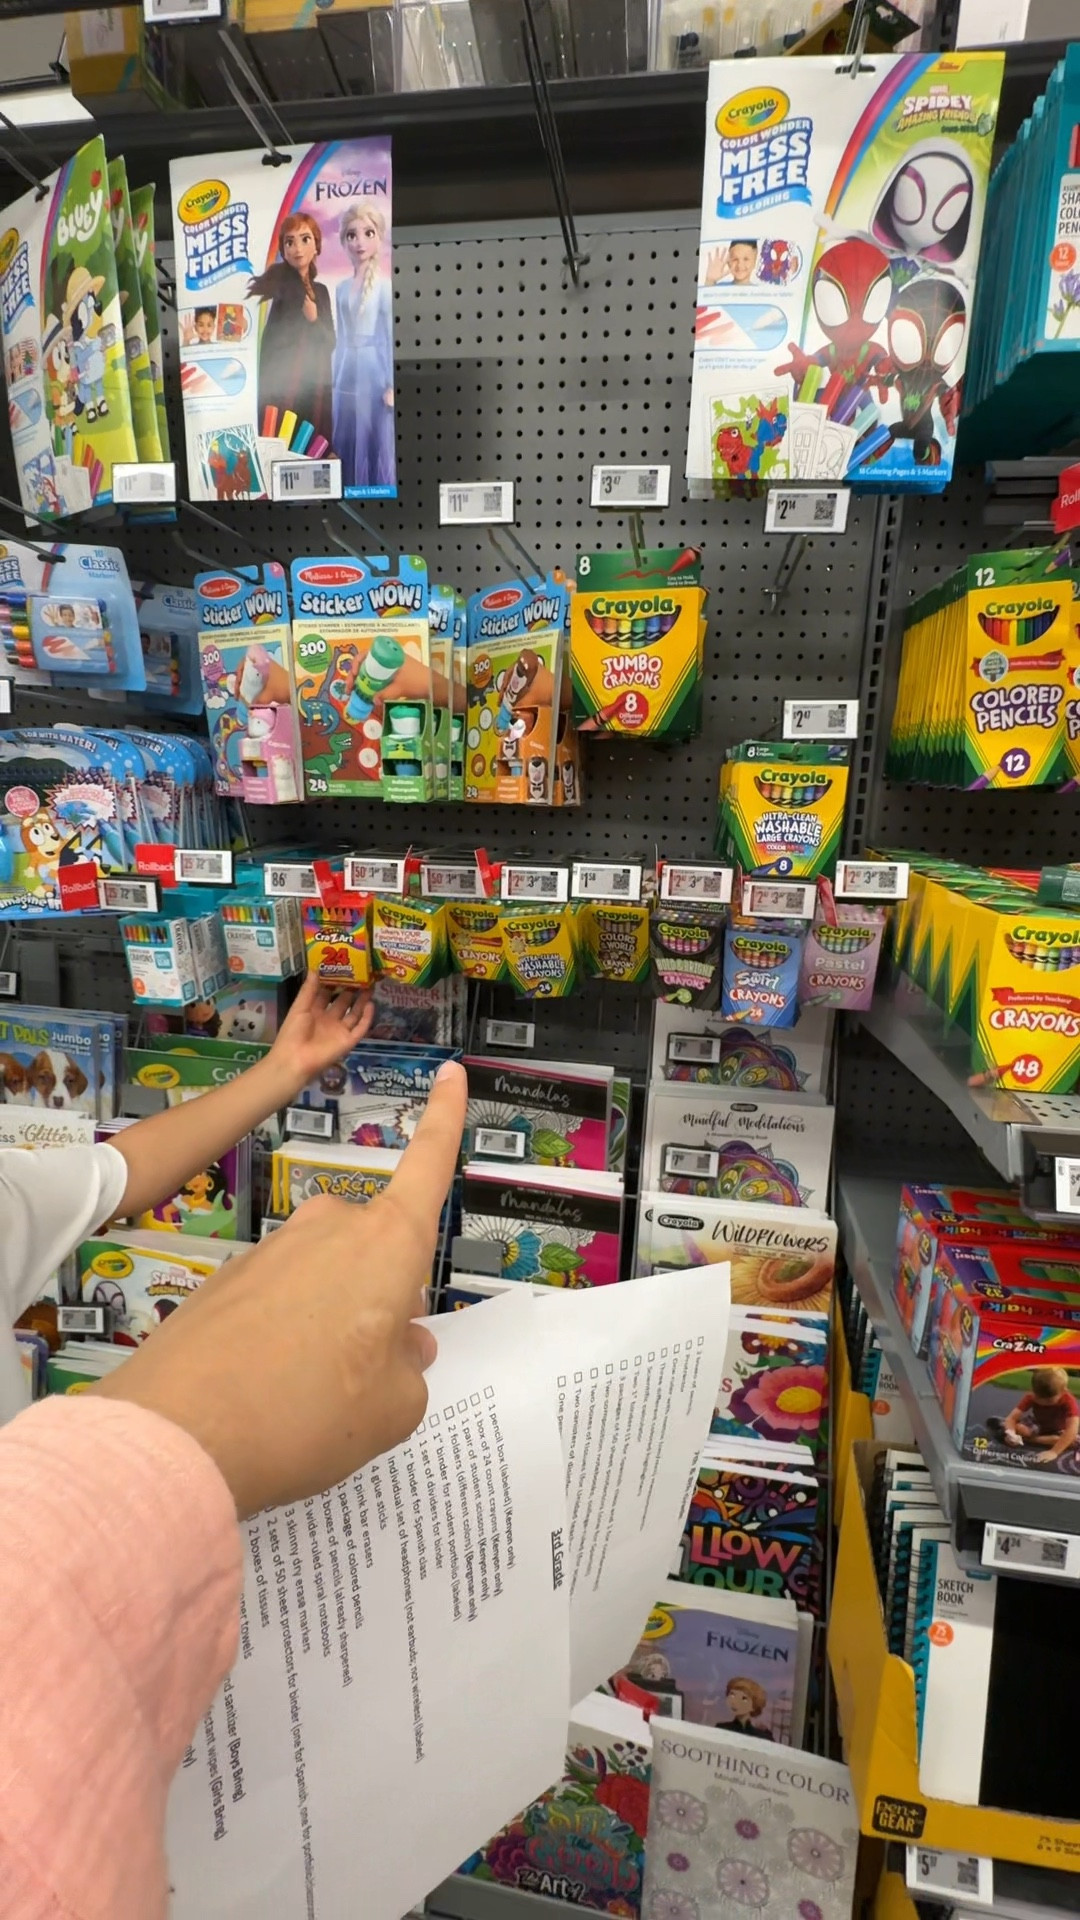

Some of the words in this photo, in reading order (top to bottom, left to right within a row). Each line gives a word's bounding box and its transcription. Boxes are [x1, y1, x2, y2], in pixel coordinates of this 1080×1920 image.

[728, 97, 775, 119] Crayola
[903, 95, 972, 116] SPIDEY
[722, 134, 757, 150] COLOR
[760, 119, 810, 139] WONDER
[722, 132, 809, 177] MESS
[315, 178, 387, 201] FROZEN
[722, 159, 806, 204] FREE
[185, 188, 222, 208] Crayola
[735, 191, 790, 217] COLORING
[184, 218, 211, 234] COLOR
[212, 204, 248, 225] WONDER
[186, 215, 247, 256] MESS
[189, 236, 247, 278] FREE
[79, 556, 120, 572] Classic
[579, 556, 591, 575] 8
[975, 568, 996, 586] 12
[202, 604, 243, 626] Sticker
[244, 590, 283, 618] WOW!
[300, 591, 364, 616] Sticker
[369, 584, 423, 610] WOW!
[592, 595, 674, 618] Crayola
[986, 598, 1053, 616] Crayola
[481, 613, 519, 636] Sticker
[523, 596, 560, 622] WOW!
[299, 640, 327, 657] 300
[203, 653, 220, 665] 300
[473, 659, 490, 675] 300
[602, 654, 662, 673] JUMBO
[603, 671, 660, 689] CRAYONS
[625, 693, 638, 712] 8
[972, 686, 1063, 712] COLORED
[977, 705, 1057, 733] PENCILS
[59, 734, 97, 752] WATER!
[747, 747, 755, 757] 8
[1006, 754, 1025, 771] 12
[216, 780, 230, 792] 24
[308, 778, 327, 792] 24
[761, 769, 827, 785] Crayola
[466, 785, 478, 797] 24
[763, 812, 818, 822] ULTRA-CLEAN
[755, 820, 823, 838] WASHABLE
[756, 833, 781, 843] LARGE
[784, 834, 820, 847] CRAYONS
[138, 862, 174, 873] Rollback
[779, 859, 787, 871] 8
[62, 880, 96, 894] Rollback
[381, 906, 423, 925] Crayola
[453, 907, 496, 919] Crayola
[597, 910, 640, 921] Crayola
[508, 918, 556, 931] Crayola
[658, 924, 709, 940] Crayola
[819, 925, 871, 938] Crayola
[600, 933, 636, 943] COLORS
[607, 942, 635, 952] WORLD
[736, 937, 787, 953] Crayola
[321, 947, 349, 965] 24
[458, 950, 501, 964] CRAYONS
[815, 958, 865, 971] Pastel
[319, 963, 352, 972] Crayons
[396, 967, 405, 975] 24
[476, 965, 485, 974] 24
[517, 959, 566, 973] WASHABLE
[524, 969, 563, 979] CRAYONS
[539, 983, 551, 992] 24
[664, 975, 705, 990] CRAYONS
[809, 974, 865, 991] CRAYONS
[730, 989, 786, 1008] CRAYONS
[750, 1008, 762, 1018] 24
[991, 1008, 1080, 1037] CRAYONS
[12, 1024, 49, 1046] PALS
[52, 1032, 91, 1045] Jumbo
[1013, 1058, 1039, 1077] 48
[494, 1075, 571, 1109] Mandalas
[682, 1110, 730, 1131] Mindful
[738, 1113, 805, 1133] Meditations
[24, 1124, 74, 1143] Glitter
[500, 1190, 583, 1222] Mandalas
[659, 1215, 700, 1228] Crayola
[460, 1427, 473, 1447] pair
[476, 1420, 486, 1439] box
[489, 1414, 503, 1443] pencil
[450, 1434, 464, 1470] folders
[481, 1443, 490, 1453] of
[974, 1436, 988, 1449] 12
[467, 1450, 477, 1459] of
[482, 1455, 492, 1466] 24
[497, 1446, 506, 1463] box
[370, 1475, 383, 1499] glue
[406, 1463, 419, 1497] binder
[470, 1462, 482, 1500] student
[485, 1468, 495, 1496] count
[498, 1464, 512, 1507] (labeled)
[352, 1484, 368, 1508] pink
[455, 1472, 470, 1517] (different
[376, 1501, 388, 1530] sticks
[412, 1500, 423, 1515] for
[489, 1498, 499, 1533] crayons
[358, 1511, 370, 1528] bar
[476, 1502, 486, 1537] scissors
[503, 1507, 514, 1545] (Kenyon
[285, 1520, 301, 1557] skinny
[413, 1516, 427, 1555] Spanish
[462, 1519, 472, 1551] colors)
[553, 1528, 563, 1549] 3rd
[362, 1531, 375, 1569] erasers
[490, 1533, 502, 1571] (Kenyon
[290, 1558, 304, 1578] dry
[418, 1556, 428, 1581] class
[554, 1551, 564, 1587] Grade
[296, 1579, 307, 1610] erase
[938, 1578, 974, 1593] SKETCH
[937, 1591, 965, 1605] BOOK
[240, 1624, 254, 1659] towels
[299, 1610, 311, 1654] markers
[707, 1630, 789, 1663] FROZEN
[661, 1737, 770, 1780] SOOTHING
[776, 1768, 851, 1805] COLOR
[878, 1811, 916, 1834] GEAR
[540, 1874, 569, 1898] Art
